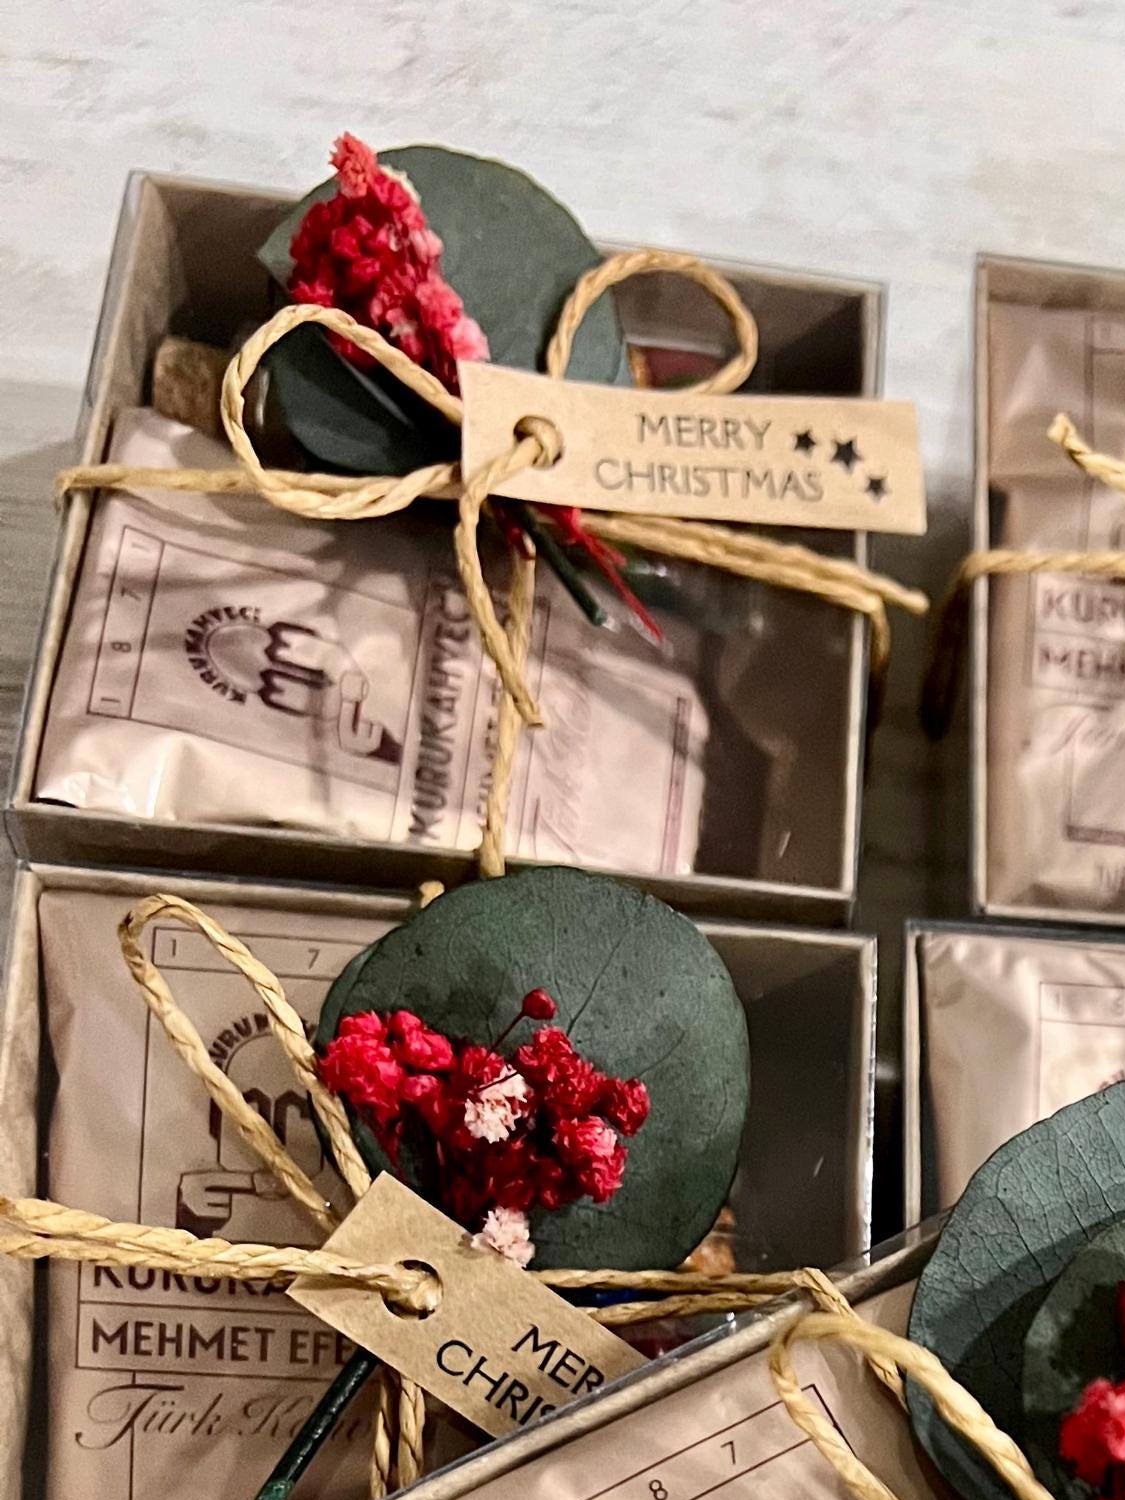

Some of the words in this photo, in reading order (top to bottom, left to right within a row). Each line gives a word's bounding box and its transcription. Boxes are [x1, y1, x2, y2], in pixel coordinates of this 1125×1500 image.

[635, 412, 772, 451] MERRY
[595, 457, 824, 502] CHRISTMAS
[307, 948, 321, 970] 7
[91, 1318, 276, 1363] MEHMET
[289, 1328, 350, 1366] EFE
[511, 1323, 606, 1395] MER
[720, 1440, 736, 1465] 7
